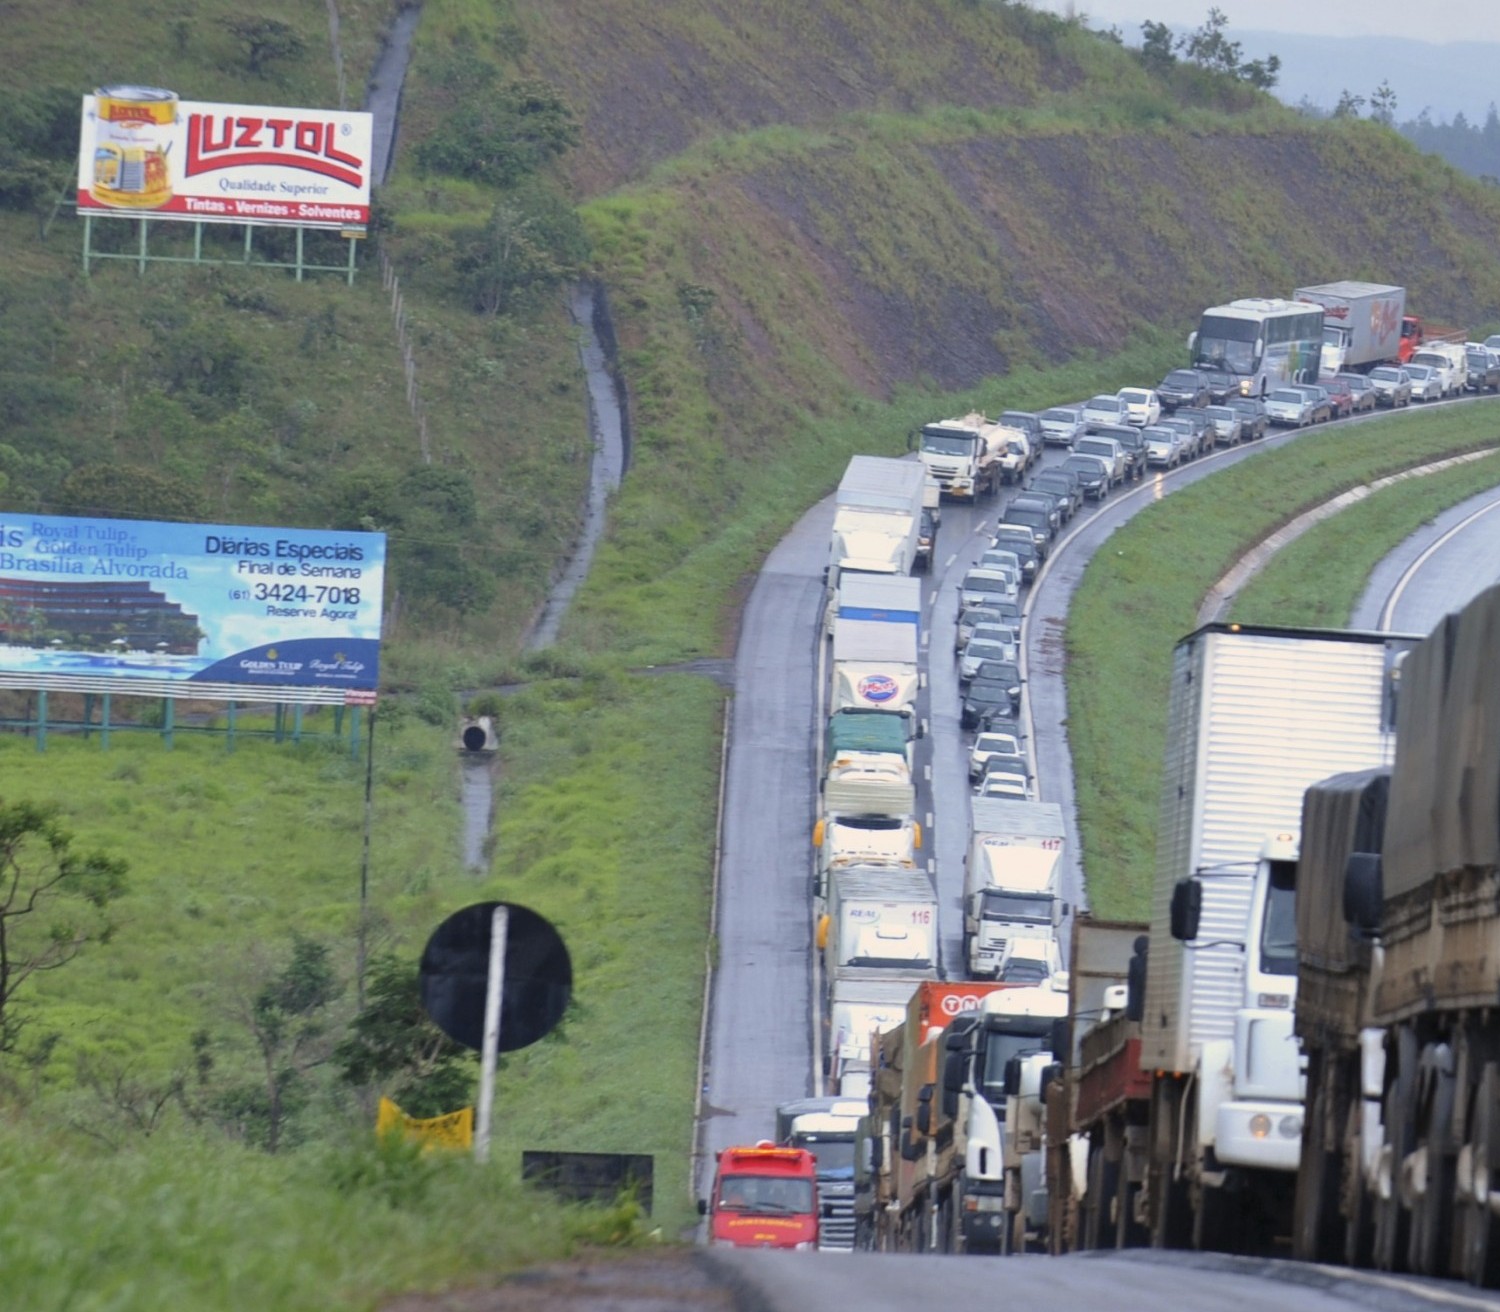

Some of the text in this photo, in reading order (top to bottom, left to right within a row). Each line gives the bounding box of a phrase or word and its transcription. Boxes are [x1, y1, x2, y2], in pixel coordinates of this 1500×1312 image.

[185, 113, 363, 188] LUZTOL
[219, 178, 329, 196] Qualidade Superior
[185, 197, 362, 220] Tintas Vernizes Solventes
[32, 522, 78, 541] Royal
[85, 525, 129, 543] Tulip
[35, 539, 148, 561] Golden Tulip
[205, 536, 364, 563] Diárias Especiais
[92, 558, 189, 580] Alvorada
[238, 560, 361, 579] Final de Semana
[228, 583, 360, 605] (61) 3424-7018
[266, 605, 317, 618] Reserve
[1041, 839, 1061, 851] 117
[911, 911, 931, 925] 116
